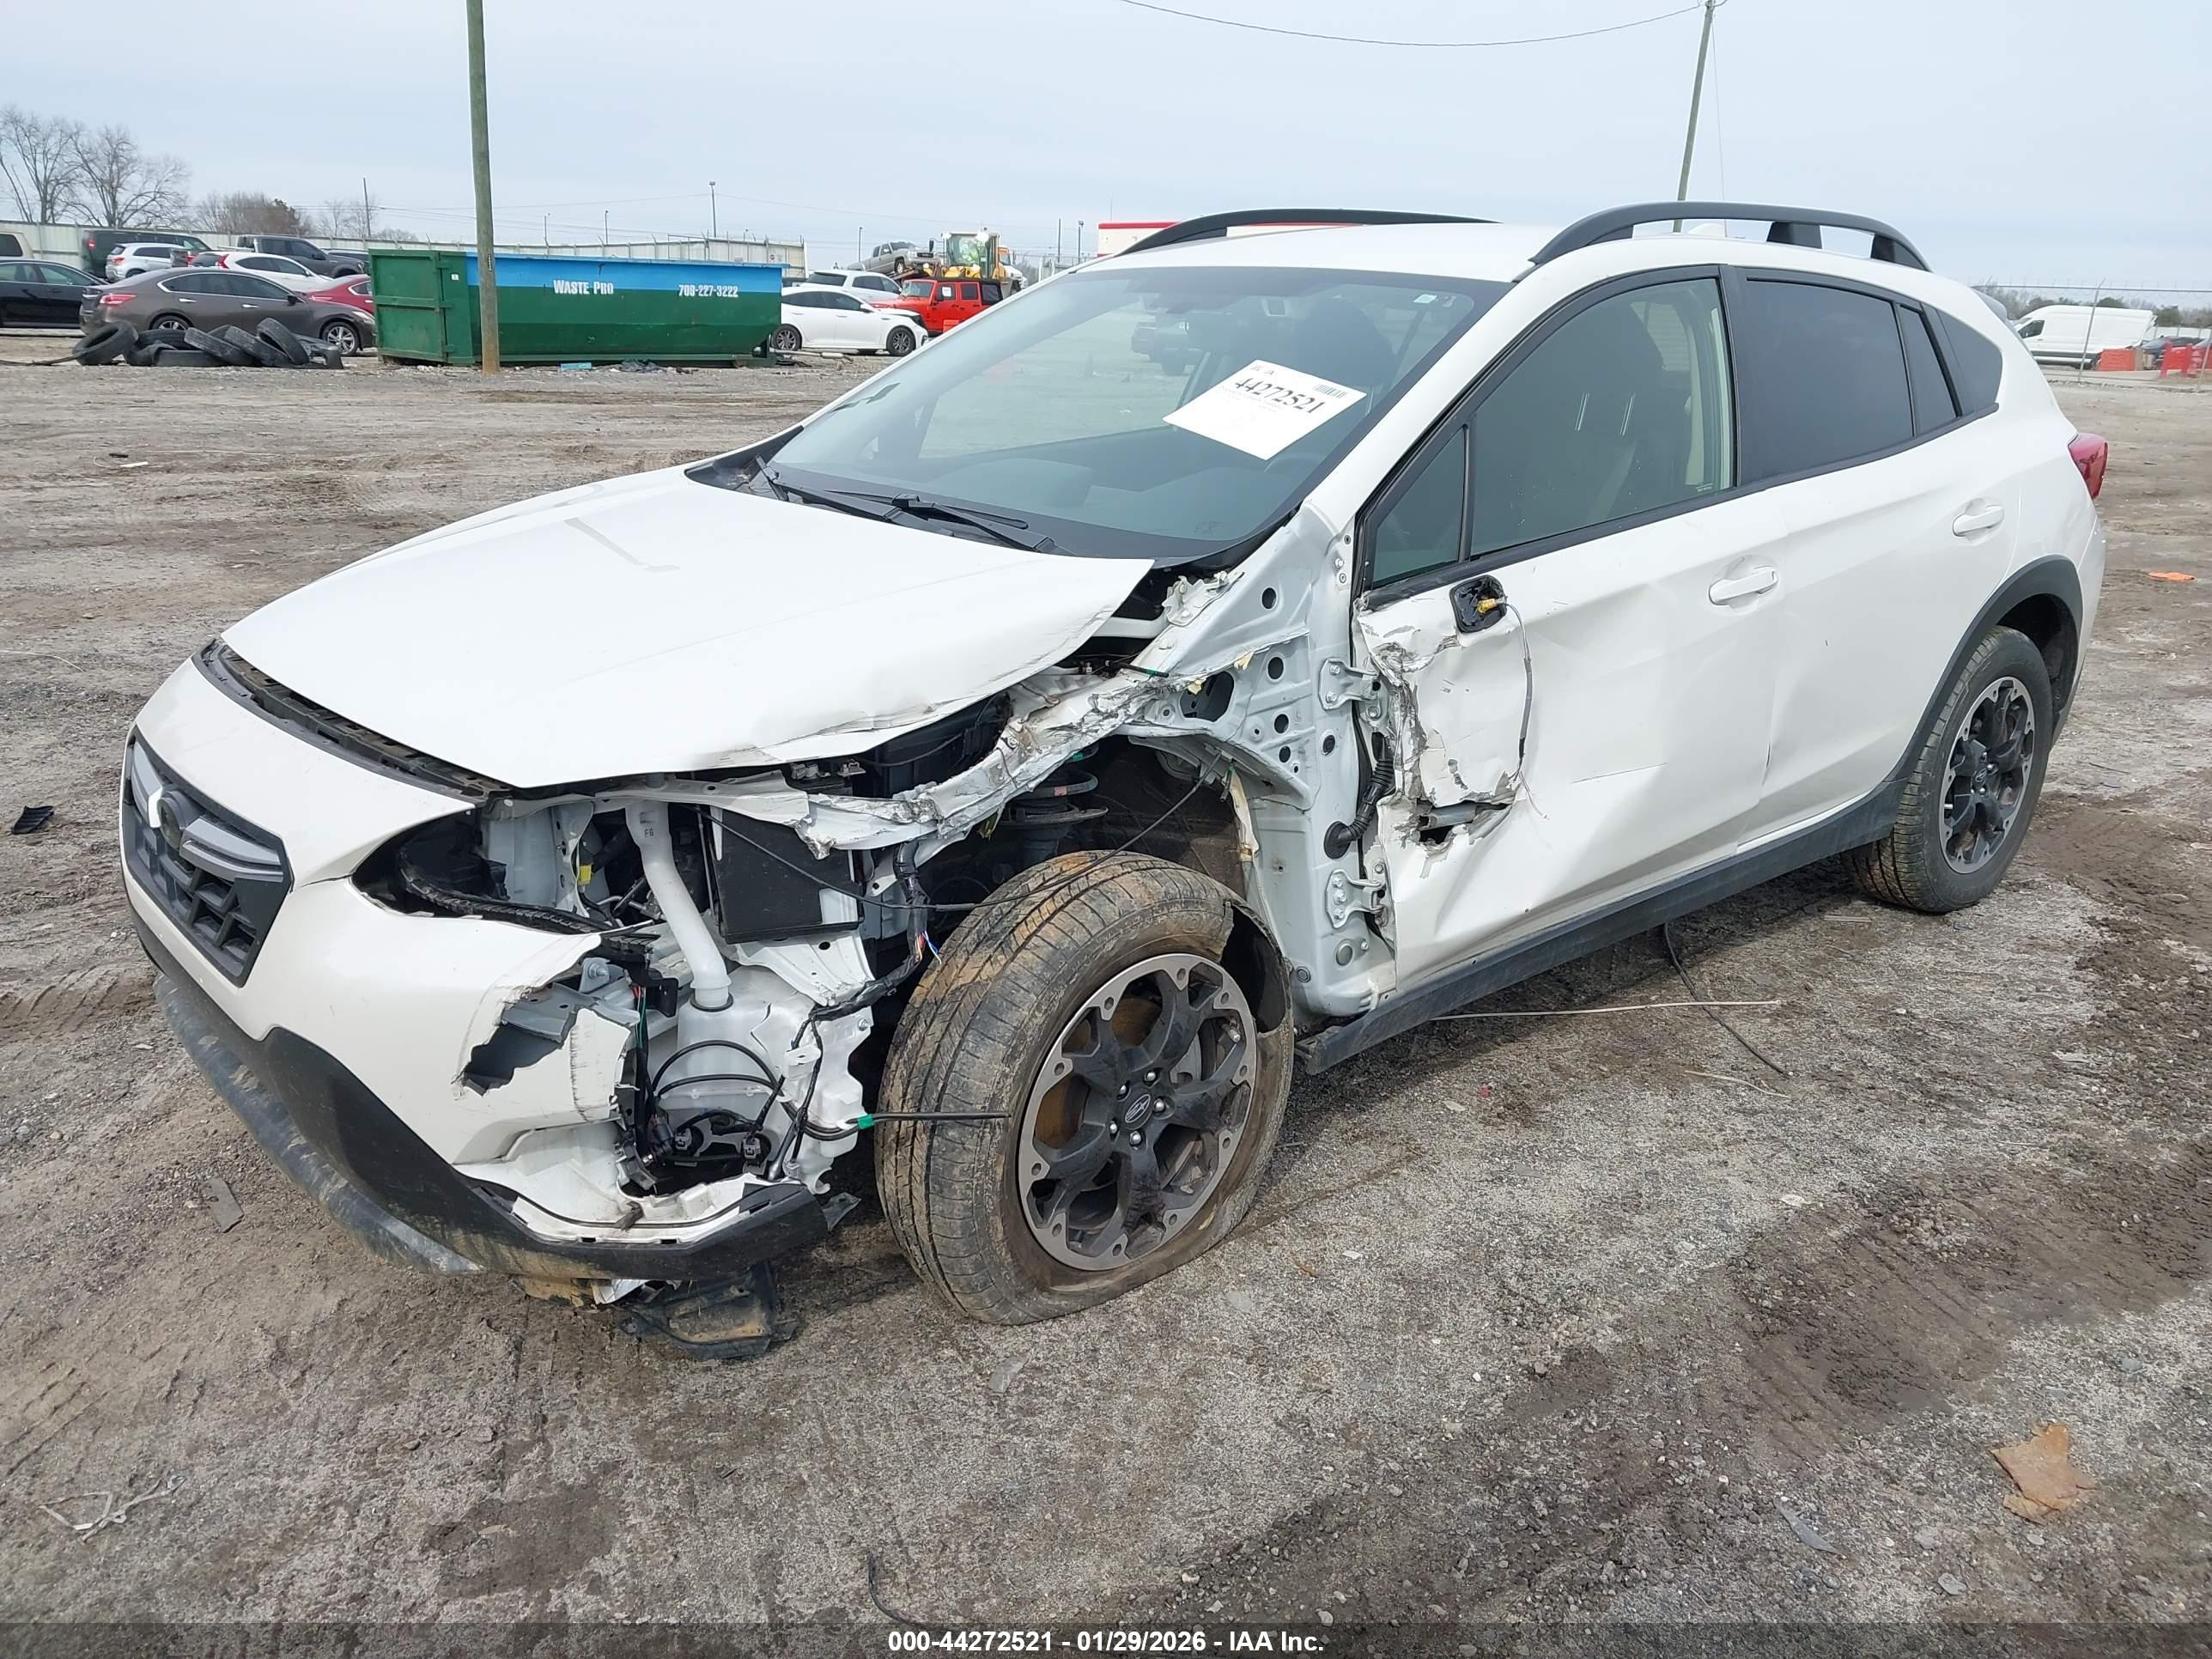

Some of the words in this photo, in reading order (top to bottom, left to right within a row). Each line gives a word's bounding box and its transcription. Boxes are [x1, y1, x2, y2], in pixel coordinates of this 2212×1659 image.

[553, 279, 590, 295] WASTE
[592, 281, 614, 295] PRO
[1234, 377, 1326, 414] 44272521
